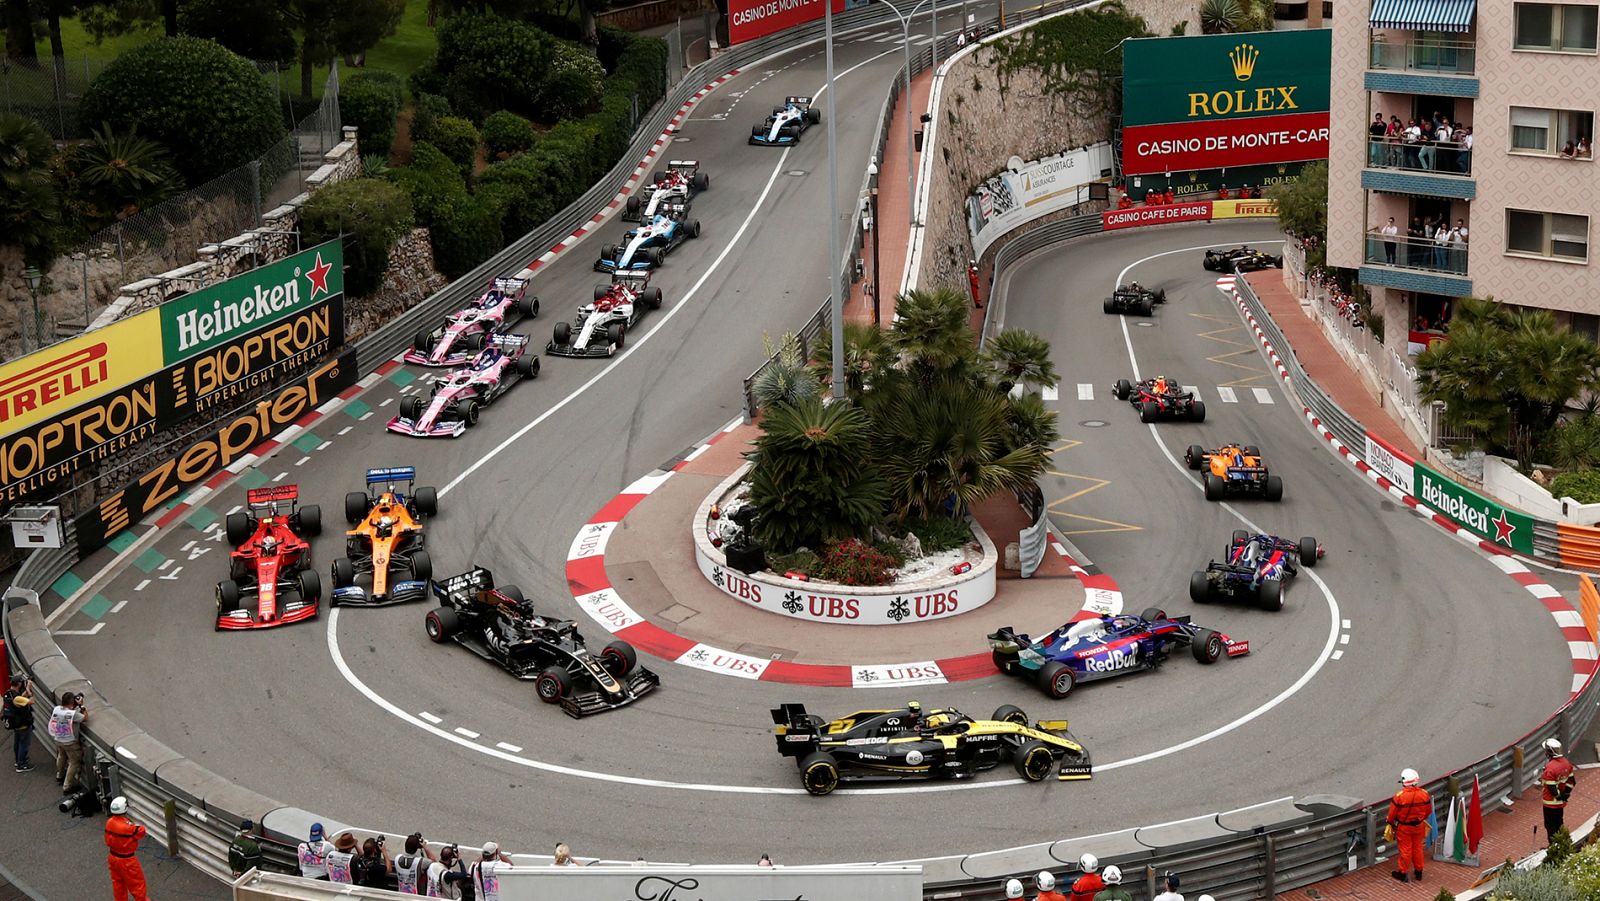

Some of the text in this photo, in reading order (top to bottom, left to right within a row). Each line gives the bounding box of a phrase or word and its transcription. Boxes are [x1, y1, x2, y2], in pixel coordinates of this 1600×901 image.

[733, 5, 766, 26] CASINO
[766, 3, 778, 16] DE
[1187, 86, 1299, 117] ROLEX
[1137, 128, 1329, 156] CASINO DE MONTE-CAR
[1177, 183, 1209, 195] ROLEX
[1107, 205, 1207, 225] CASINO CAFE DE PARIS
[177, 278, 301, 352] Heineken
[194, 304, 330, 396] BIOPTRON
[0, 342, 108, 424] IRELLI
[196, 341, 330, 413] HYPERLIGHT THERAPY
[0, 380, 157, 485] IOPTRON
[89, 421, 156, 464] THERAPY
[138, 358, 338, 513] zepter
[1421, 474, 1489, 534] Heineken
[577, 534, 601, 556] UBS
[260, 583, 272, 591] 16
[725, 573, 762, 603] UBS
[598, 603, 633, 627] UBS
[808, 595, 860, 619] UBS
[914, 590, 959, 617] UBS
[1078, 645, 1108, 658] HONDA
[712, 655, 764, 674] UBS
[885, 666, 939, 680] UBS
[828, 719, 856, 735] 27
[966, 734, 998, 743] MAPFRE
